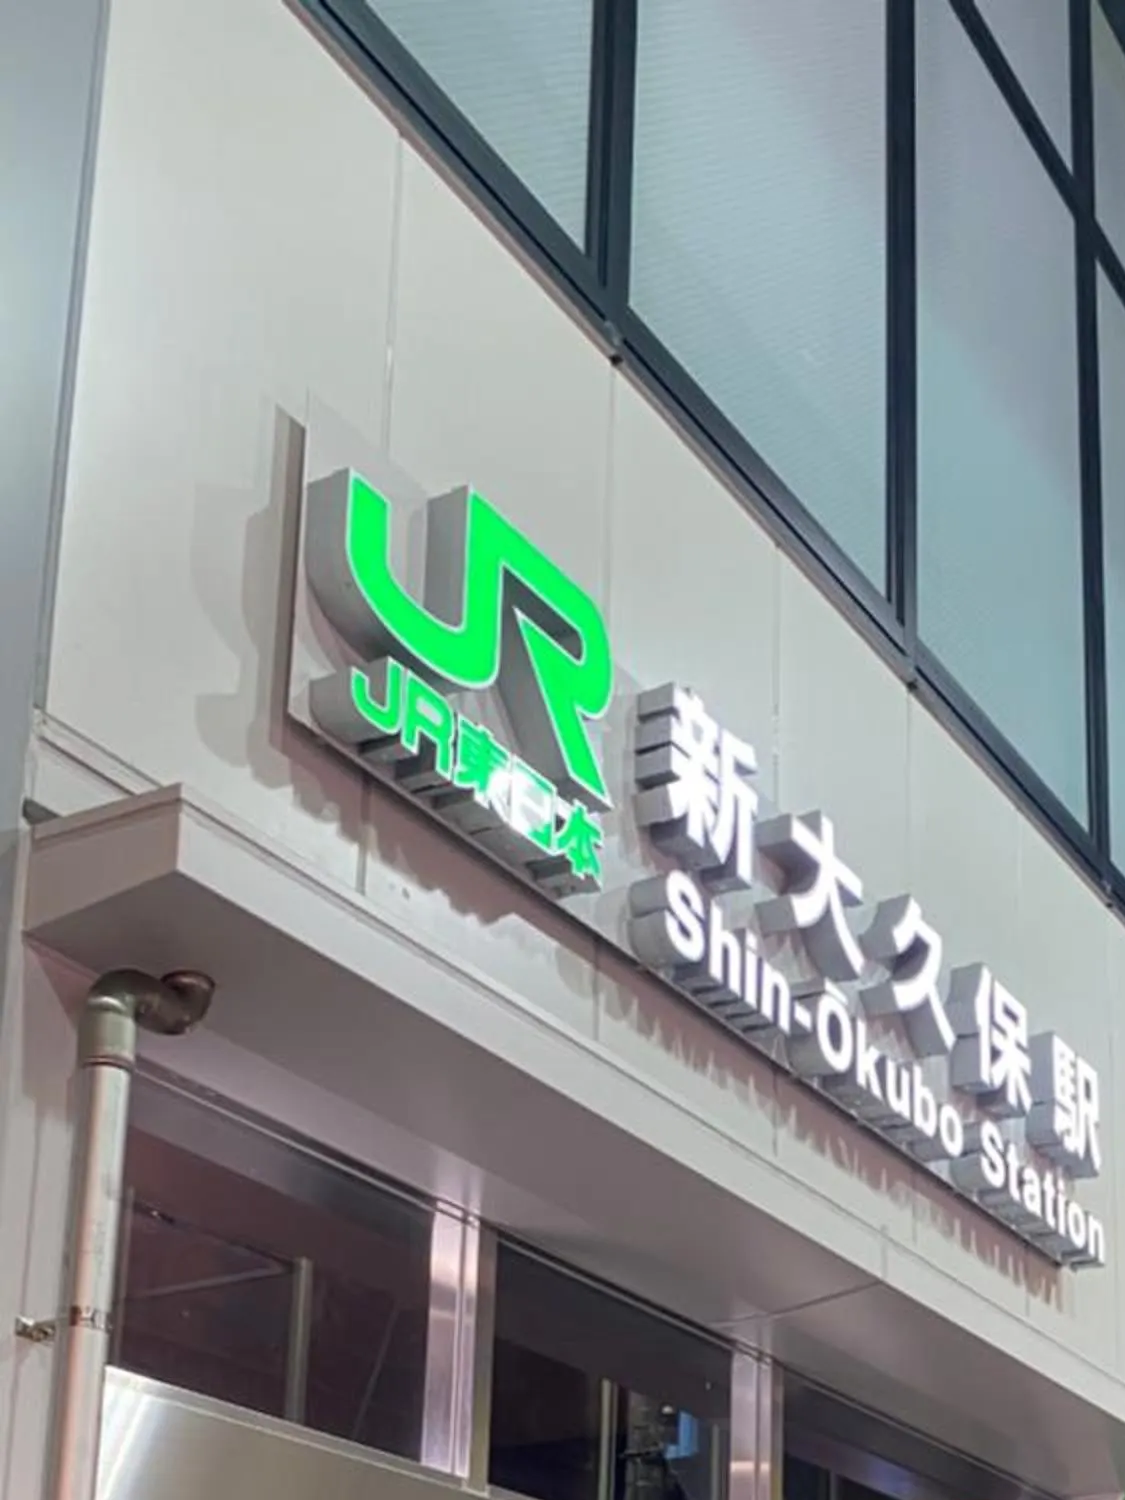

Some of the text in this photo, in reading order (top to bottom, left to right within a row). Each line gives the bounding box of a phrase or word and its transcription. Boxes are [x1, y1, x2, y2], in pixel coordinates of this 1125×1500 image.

[346, 468, 614, 806] JR
[350, 656, 604, 888] JR東日本
[669, 688, 1101, 1171] 新大久保駅
[979, 1121, 1105, 1259] Station
